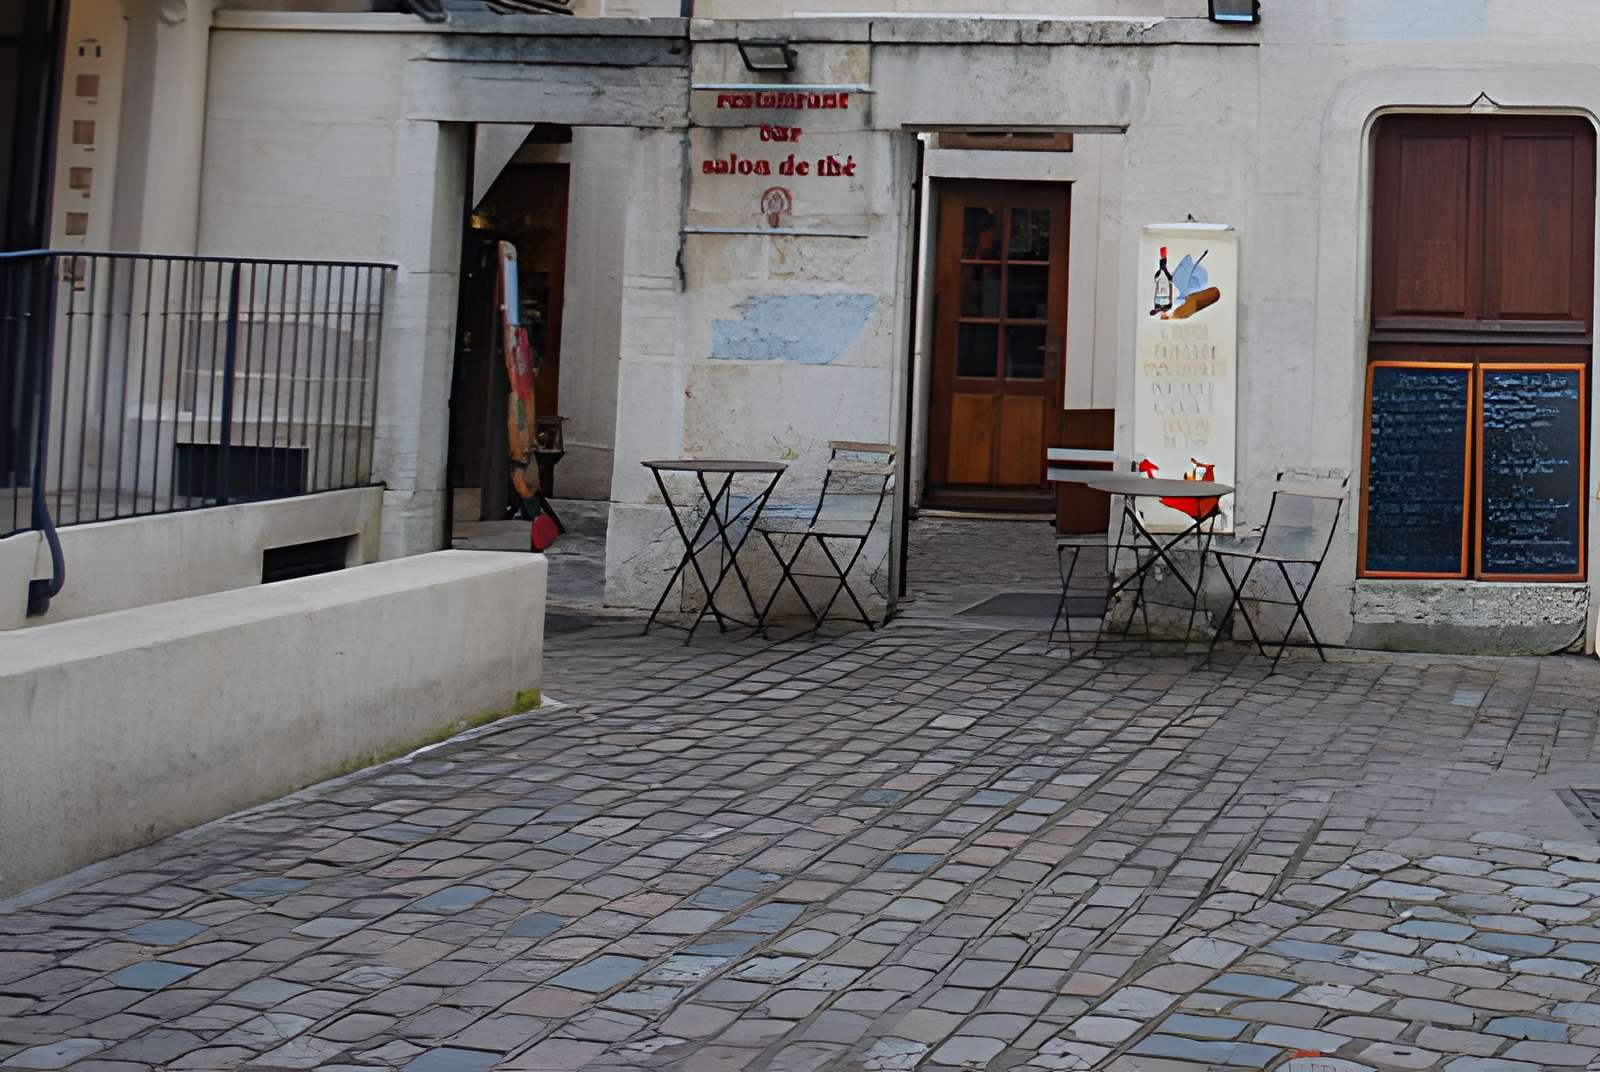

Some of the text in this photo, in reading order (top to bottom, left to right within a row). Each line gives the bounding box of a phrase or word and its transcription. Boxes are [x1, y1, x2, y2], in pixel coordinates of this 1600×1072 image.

[702, 153, 857, 177] salon de thé
